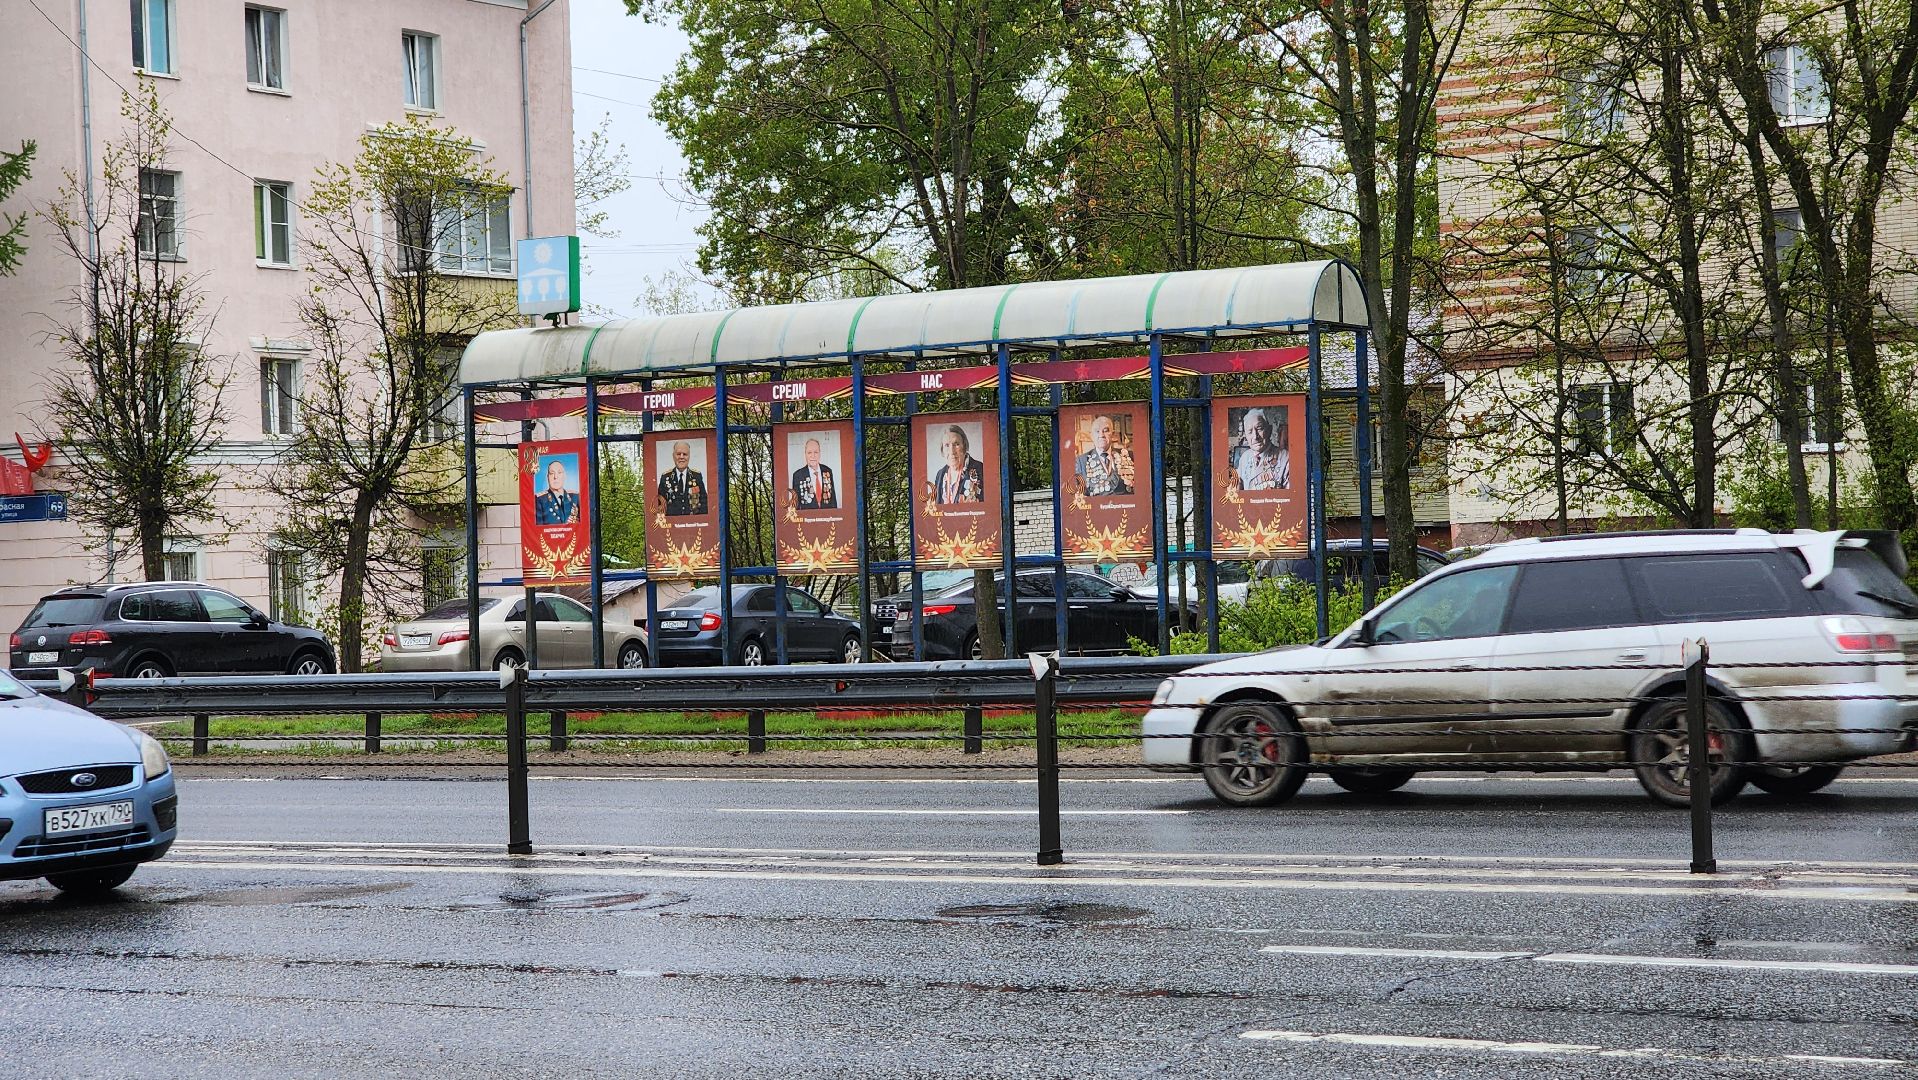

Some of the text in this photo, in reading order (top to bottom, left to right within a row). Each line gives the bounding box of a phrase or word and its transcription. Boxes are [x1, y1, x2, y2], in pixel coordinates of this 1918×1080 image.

[643, 373, 943, 409] ГЕРОИ СРЕДИ НАС
[50, 501, 64, 513] 69
[51, 803, 131, 831] В527ХК 790
